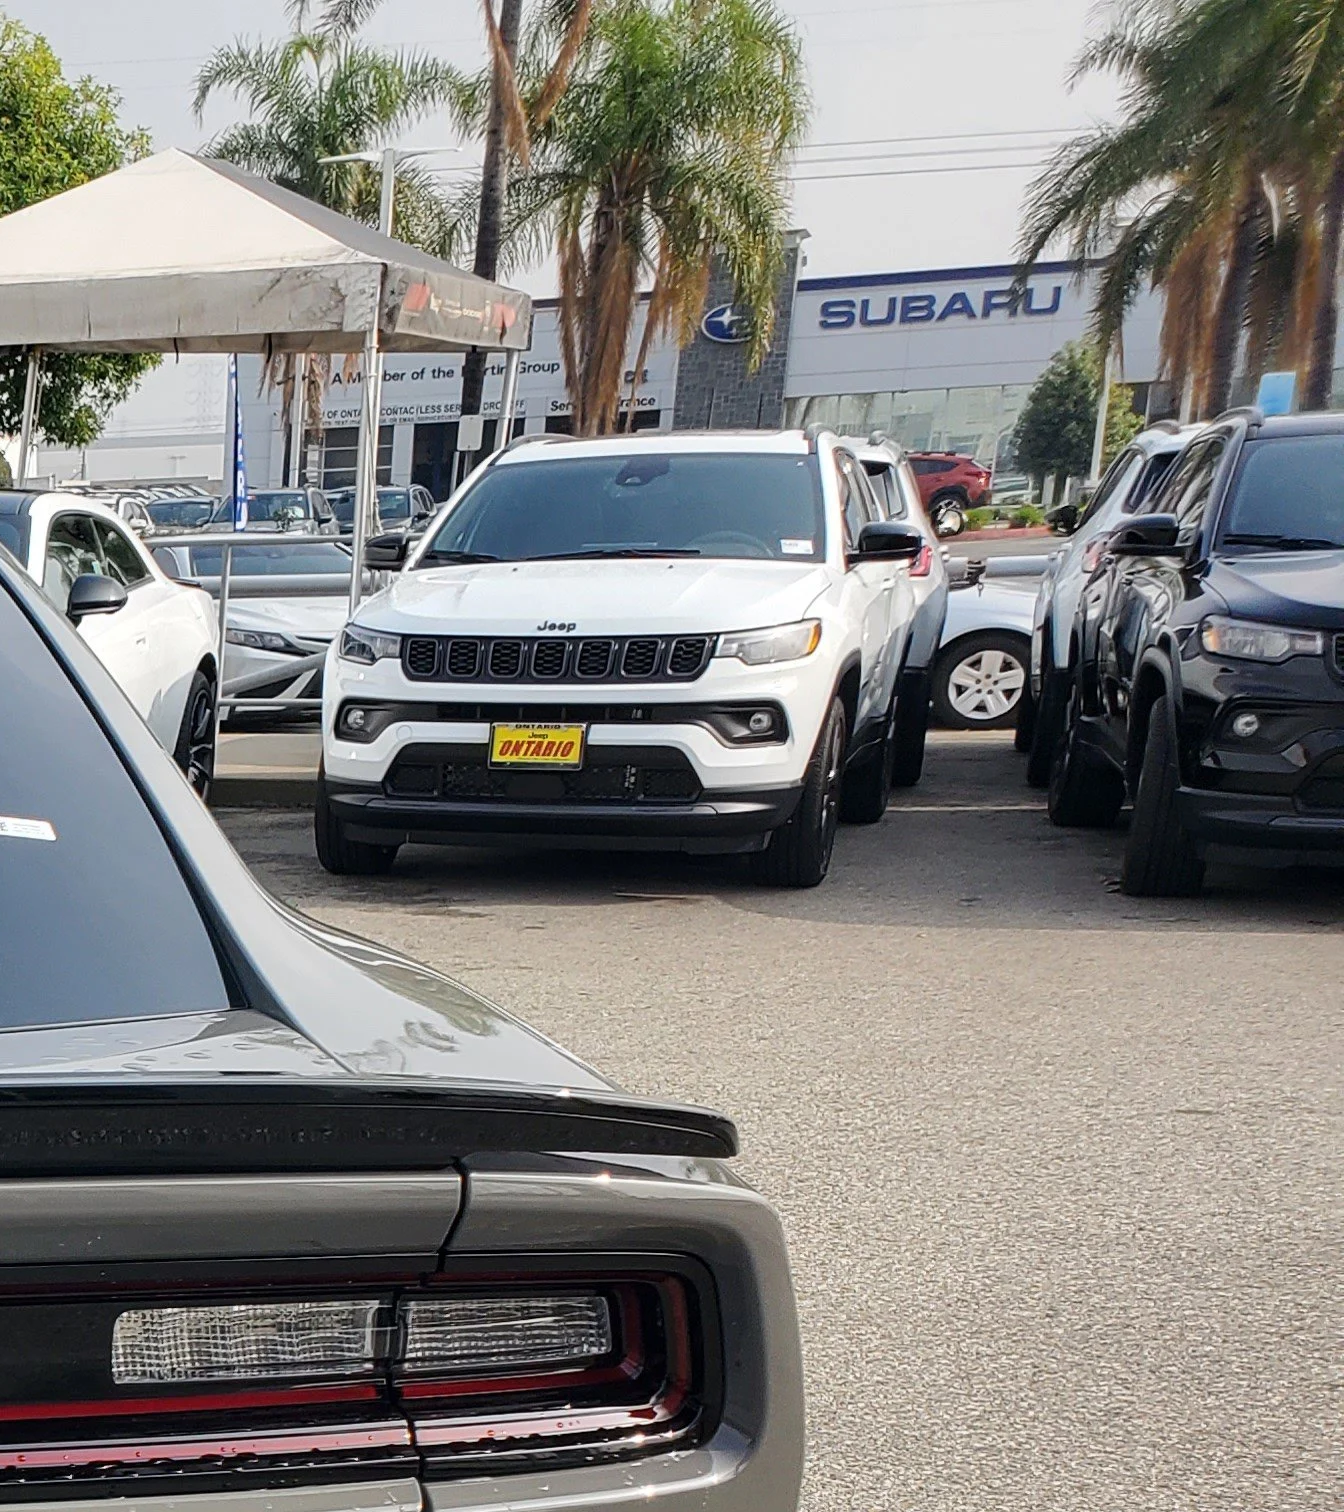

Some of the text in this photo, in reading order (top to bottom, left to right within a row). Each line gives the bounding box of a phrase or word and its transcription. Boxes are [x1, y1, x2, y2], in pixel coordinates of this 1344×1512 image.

[819, 286, 1062, 329] SUBARU
[347, 369, 406, 384] Mber
[411, 367, 426, 381] of
[432, 366, 455, 379] the
[518, 361, 560, 374] Group
[537, 620, 576, 633] Jeep
[528, 732, 548, 740] Jeep
[499, 739, 575, 758] ONTARIO
